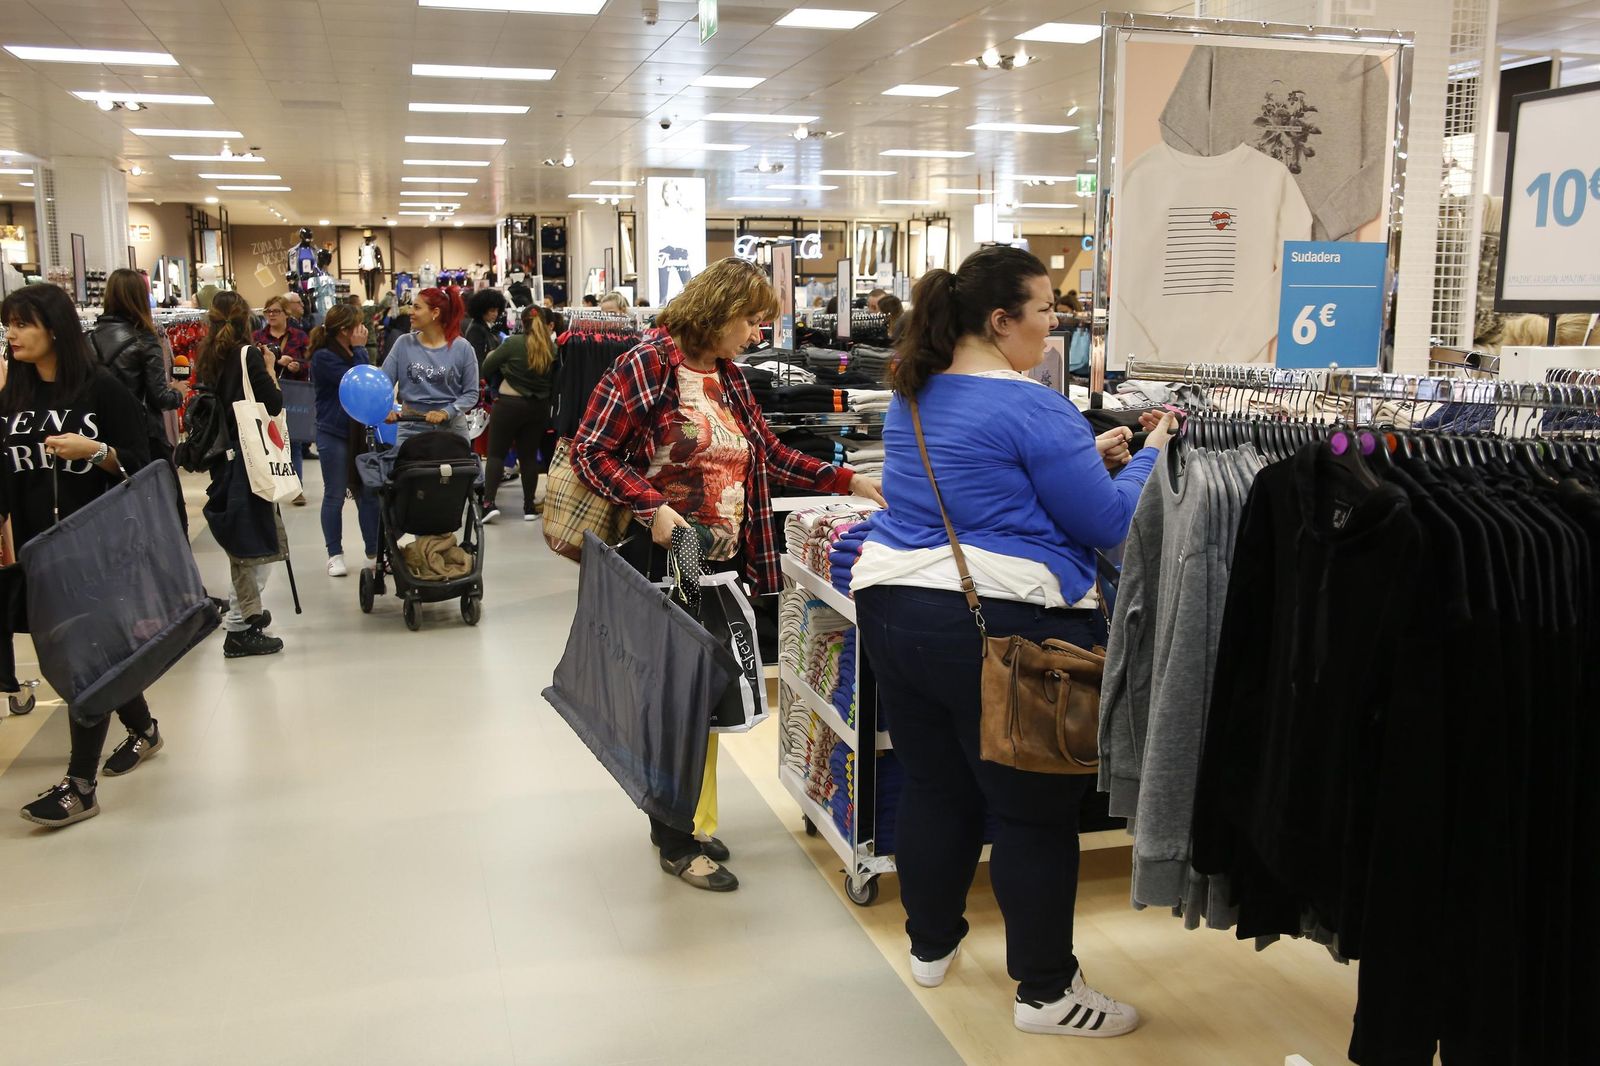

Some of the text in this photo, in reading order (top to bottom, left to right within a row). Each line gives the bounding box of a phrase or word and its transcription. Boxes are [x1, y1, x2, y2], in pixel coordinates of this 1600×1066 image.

[1291, 251, 1341, 263] Sudadera
[1292, 302, 1337, 345] 6€
[3, 442, 94, 475] RED
